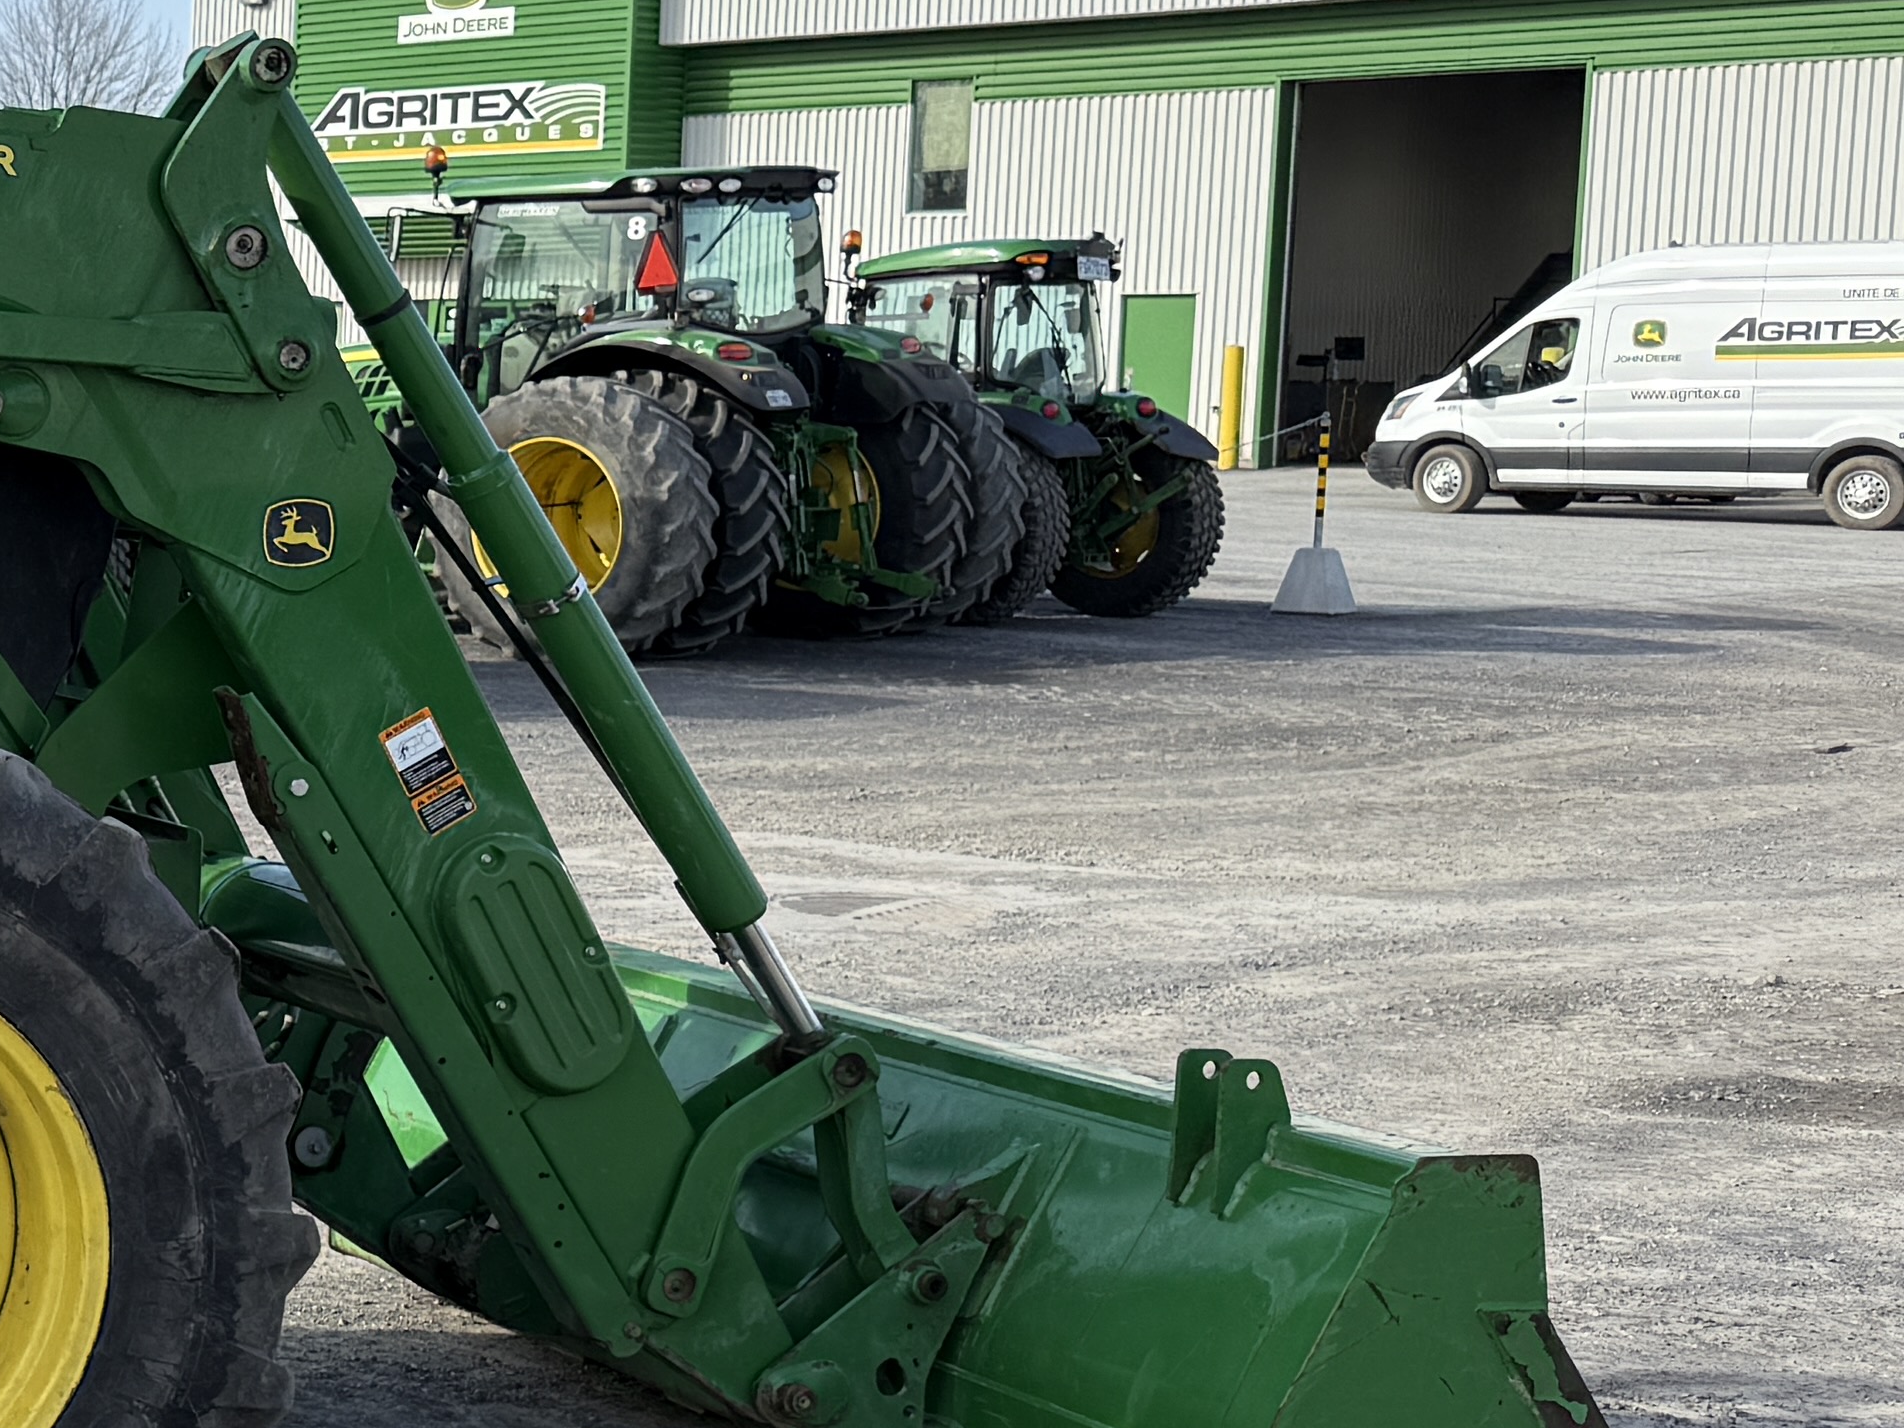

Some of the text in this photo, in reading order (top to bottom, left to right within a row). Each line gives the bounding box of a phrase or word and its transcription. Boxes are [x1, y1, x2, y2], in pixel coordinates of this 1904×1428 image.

[402, 16, 510, 38] JOHN DEERE
[314, 85, 537, 132] AGRITEX
[626, 215, 647, 241] 8
[1883, 287, 1900, 299] DE
[1716, 317, 1901, 342] AGRITEX
[1613, 353, 1682, 363] JOHN DEERE
[1630, 388, 1741, 402] www.agritex.ca
